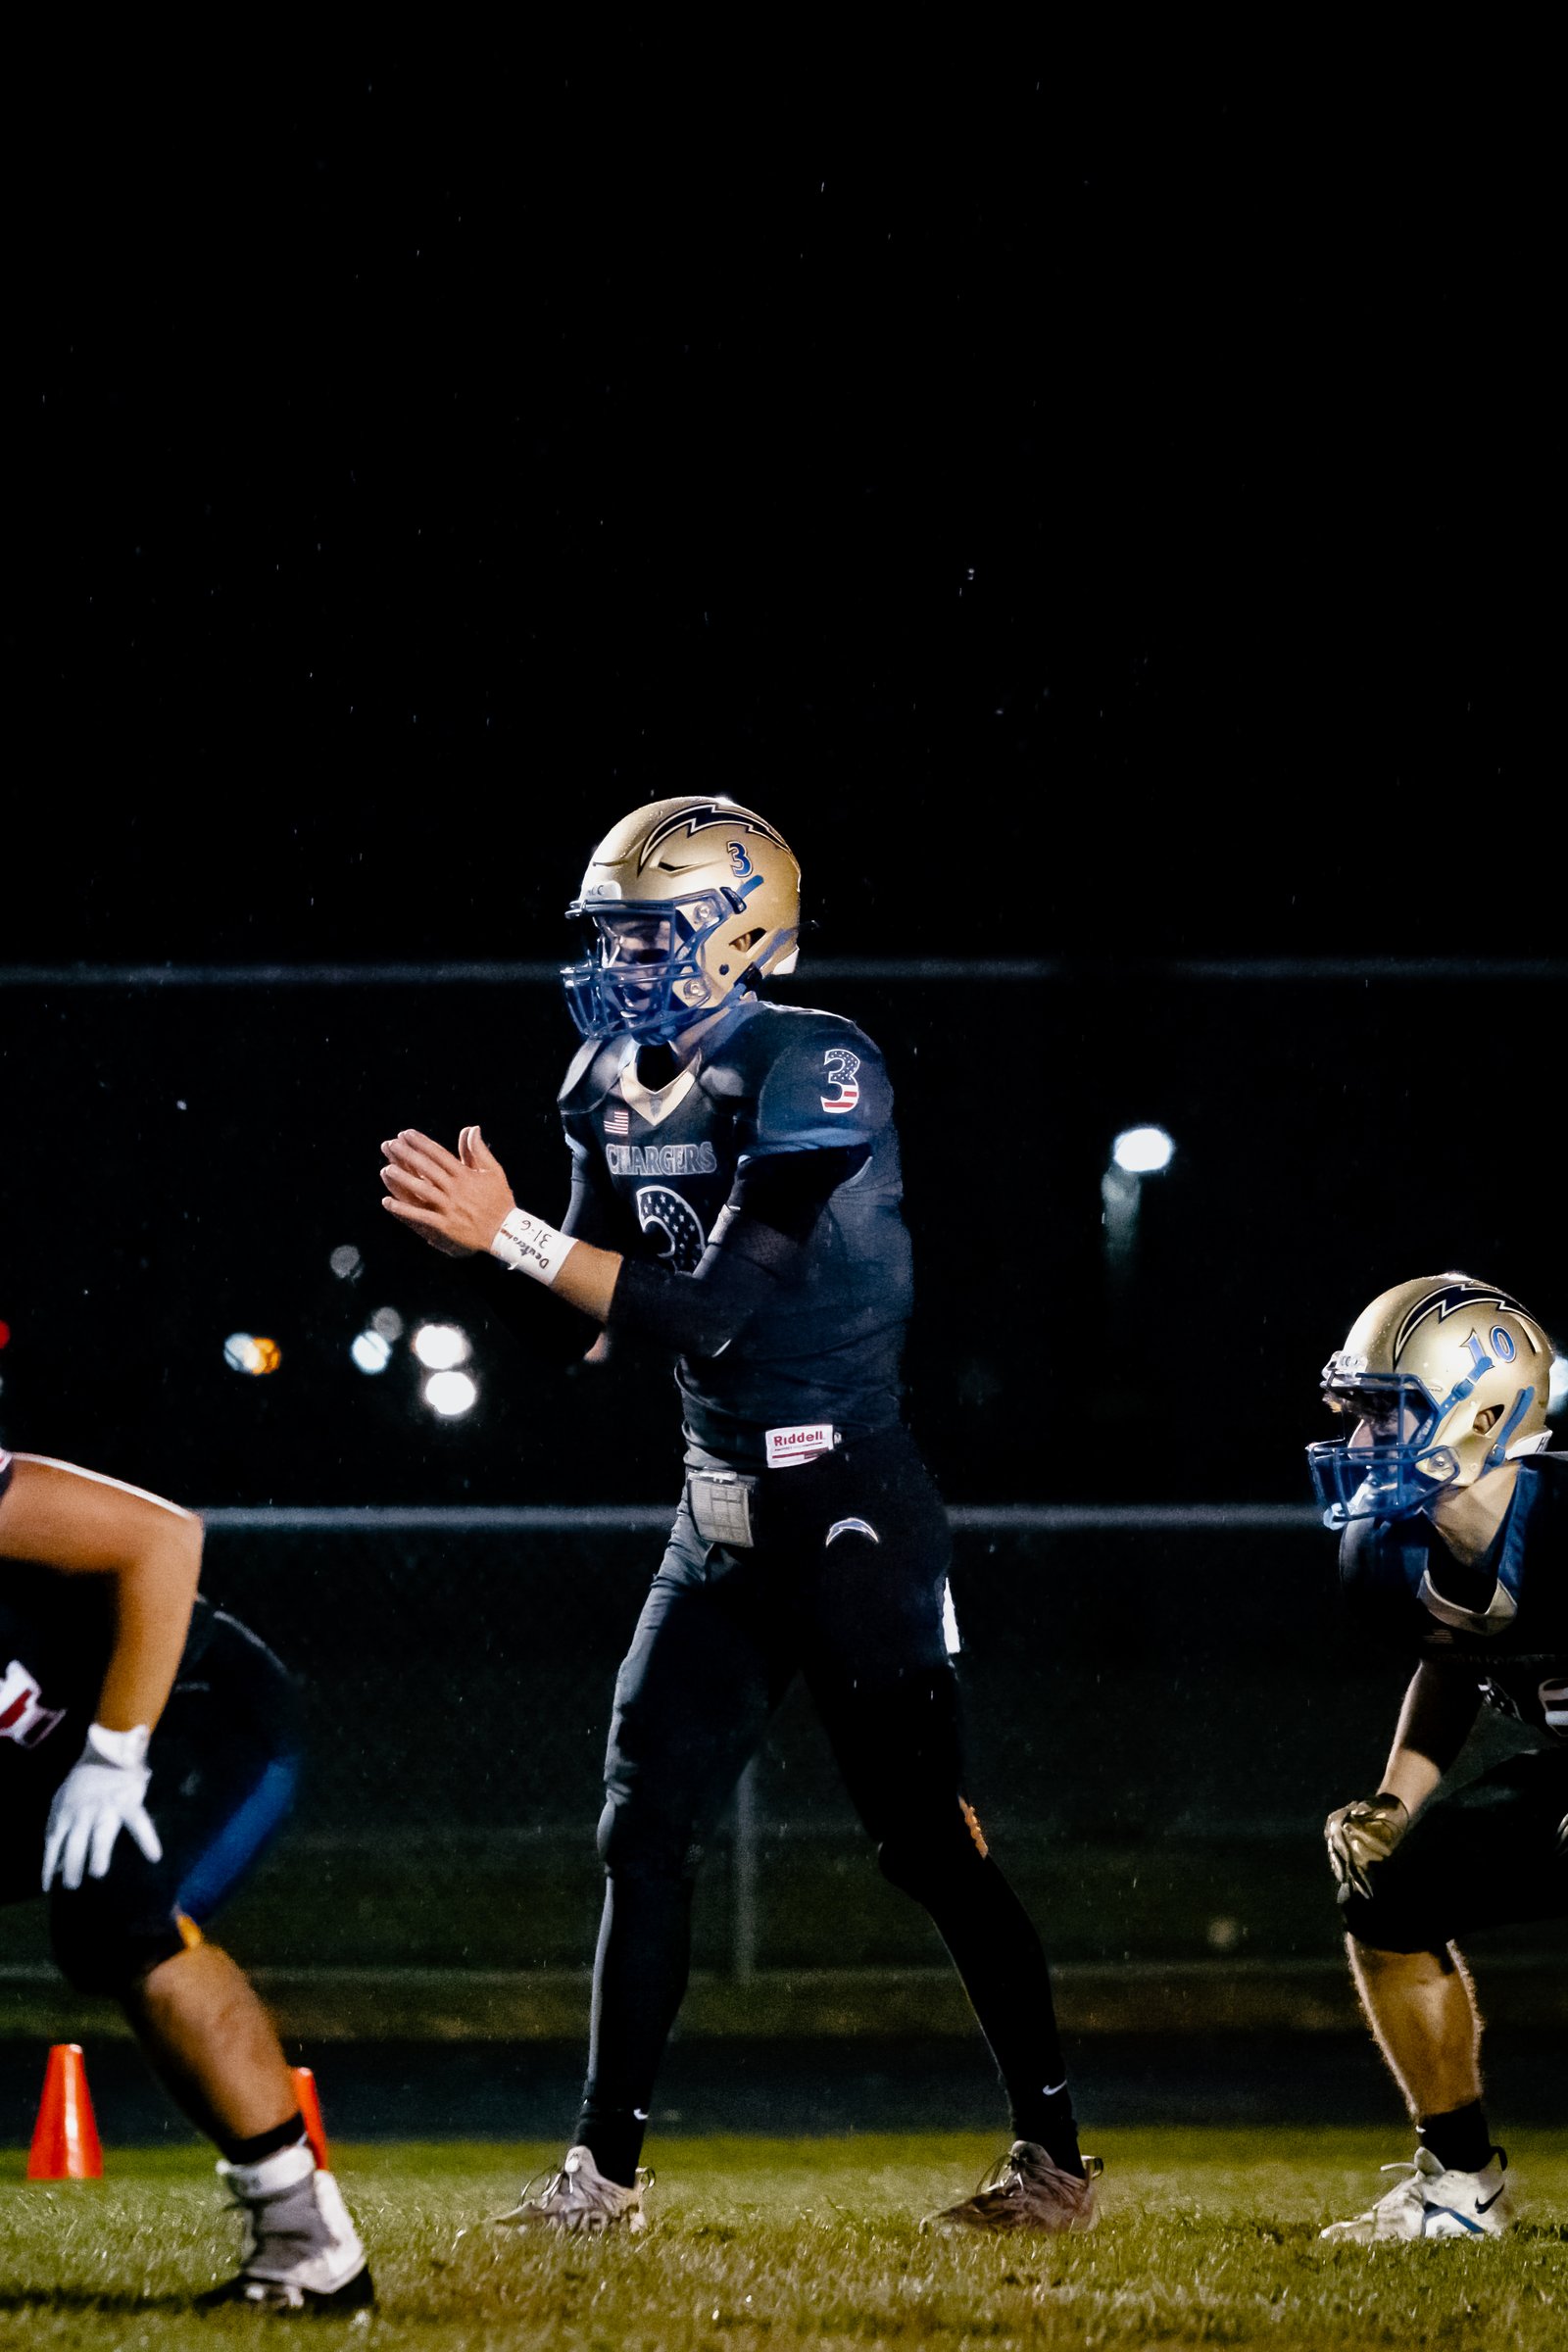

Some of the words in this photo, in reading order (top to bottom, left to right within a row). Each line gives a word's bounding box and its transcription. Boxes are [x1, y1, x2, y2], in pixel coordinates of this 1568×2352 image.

[726, 841, 753, 877] 3
[820, 1049, 860, 1113] 3
[605, 1142, 717, 1176] CHARGERS
[500, 1223, 550, 1270] Deutero
[1458, 1324, 1517, 1374] 10
[773, 1430, 823, 1446] Riddell
